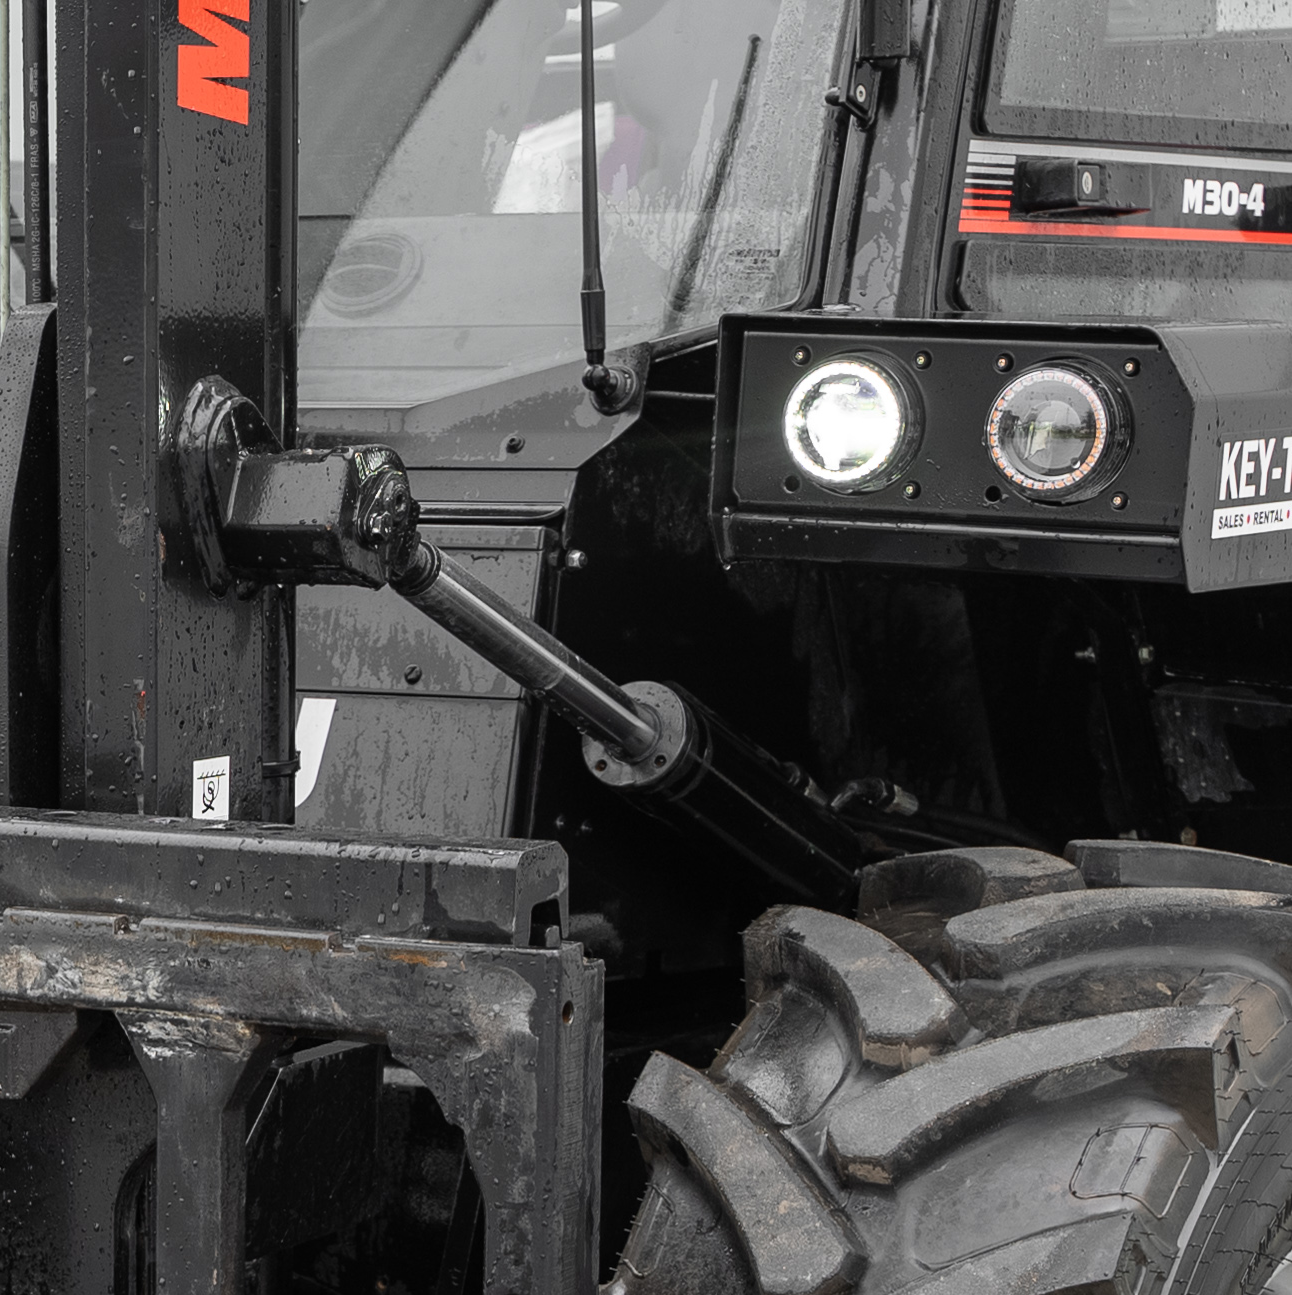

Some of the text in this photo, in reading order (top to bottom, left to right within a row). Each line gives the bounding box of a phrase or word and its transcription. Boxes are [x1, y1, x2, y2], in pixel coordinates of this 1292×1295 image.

[29, 143, 39, 168] FRAS
[1181, 178, 1265, 217] M30-4
[31, 244, 41, 272] MSHA
[1217, 508, 1284, 530] SALES RENTAL
